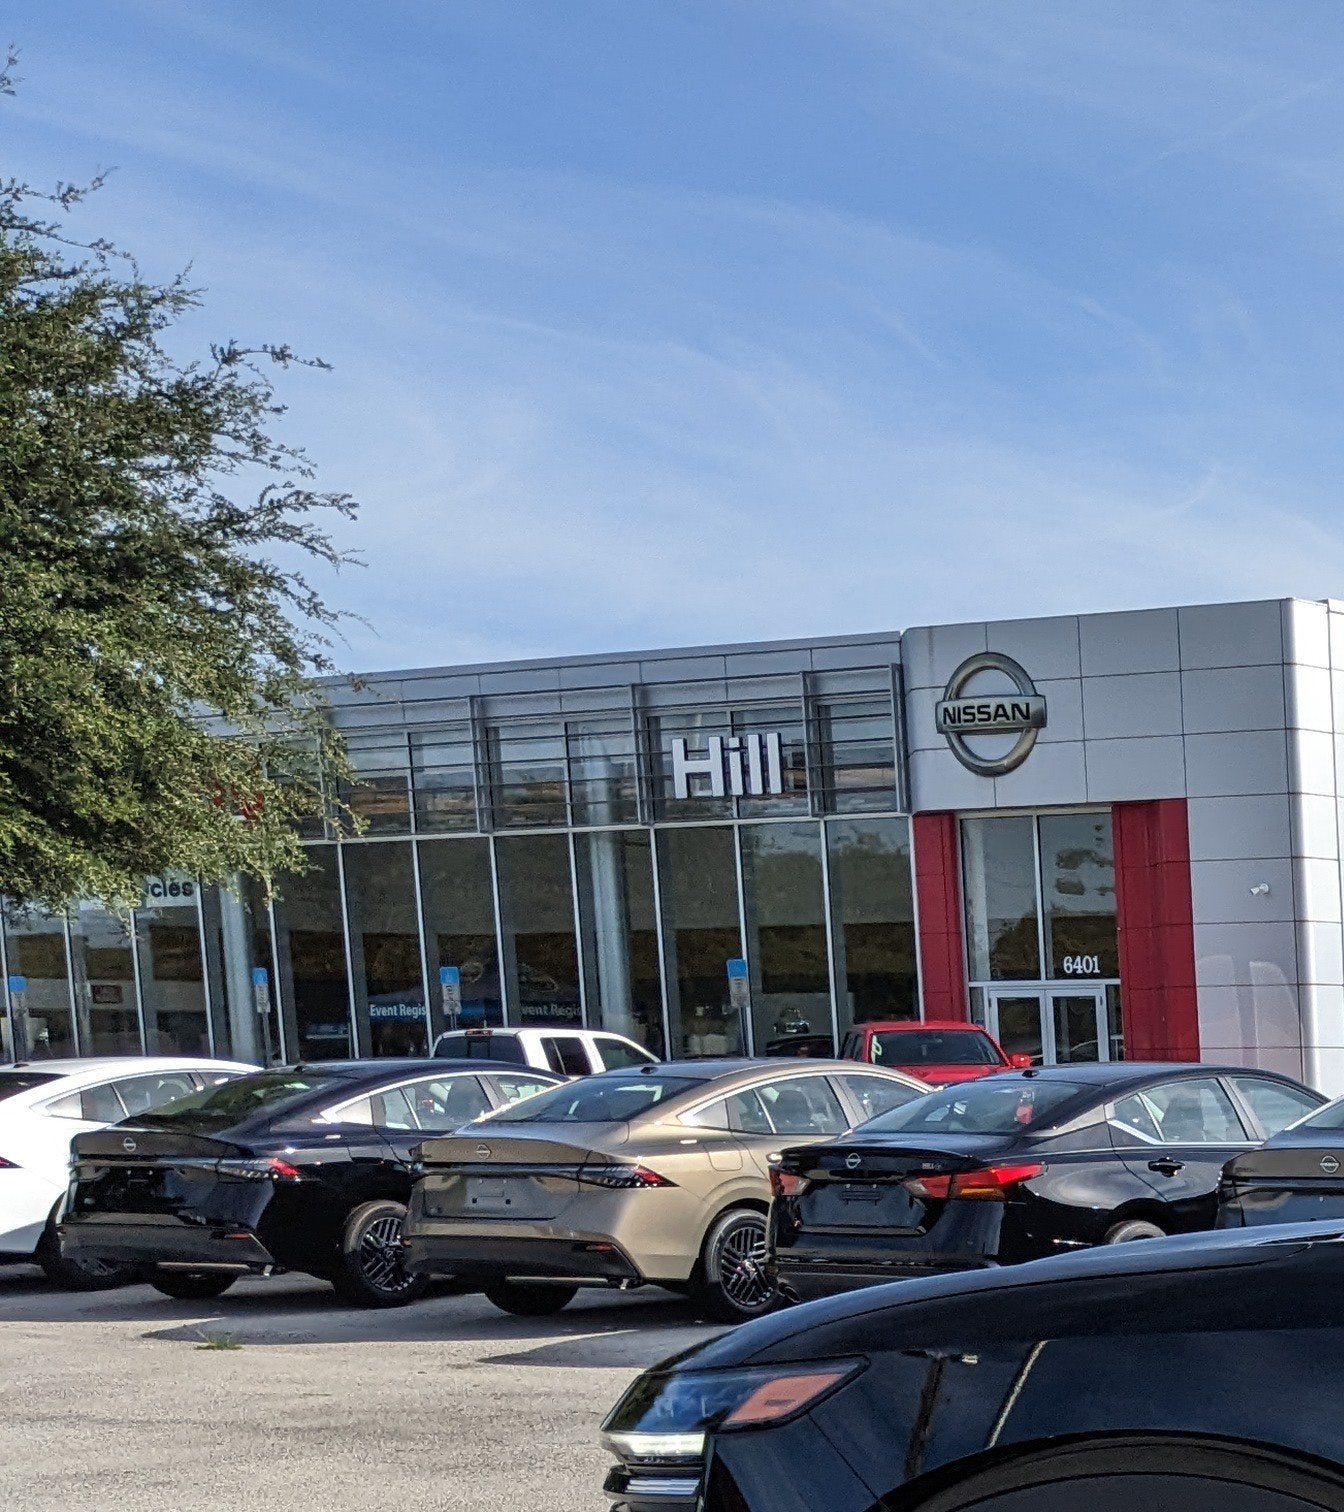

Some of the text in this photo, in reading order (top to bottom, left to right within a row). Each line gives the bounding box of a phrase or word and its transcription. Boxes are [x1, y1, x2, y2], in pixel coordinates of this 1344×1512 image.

[942, 702, 1031, 725] NISSAN
[671, 732, 783, 799] Hill
[1062, 955, 1101, 974] 6401
[369, 1003, 398, 1016] Event
